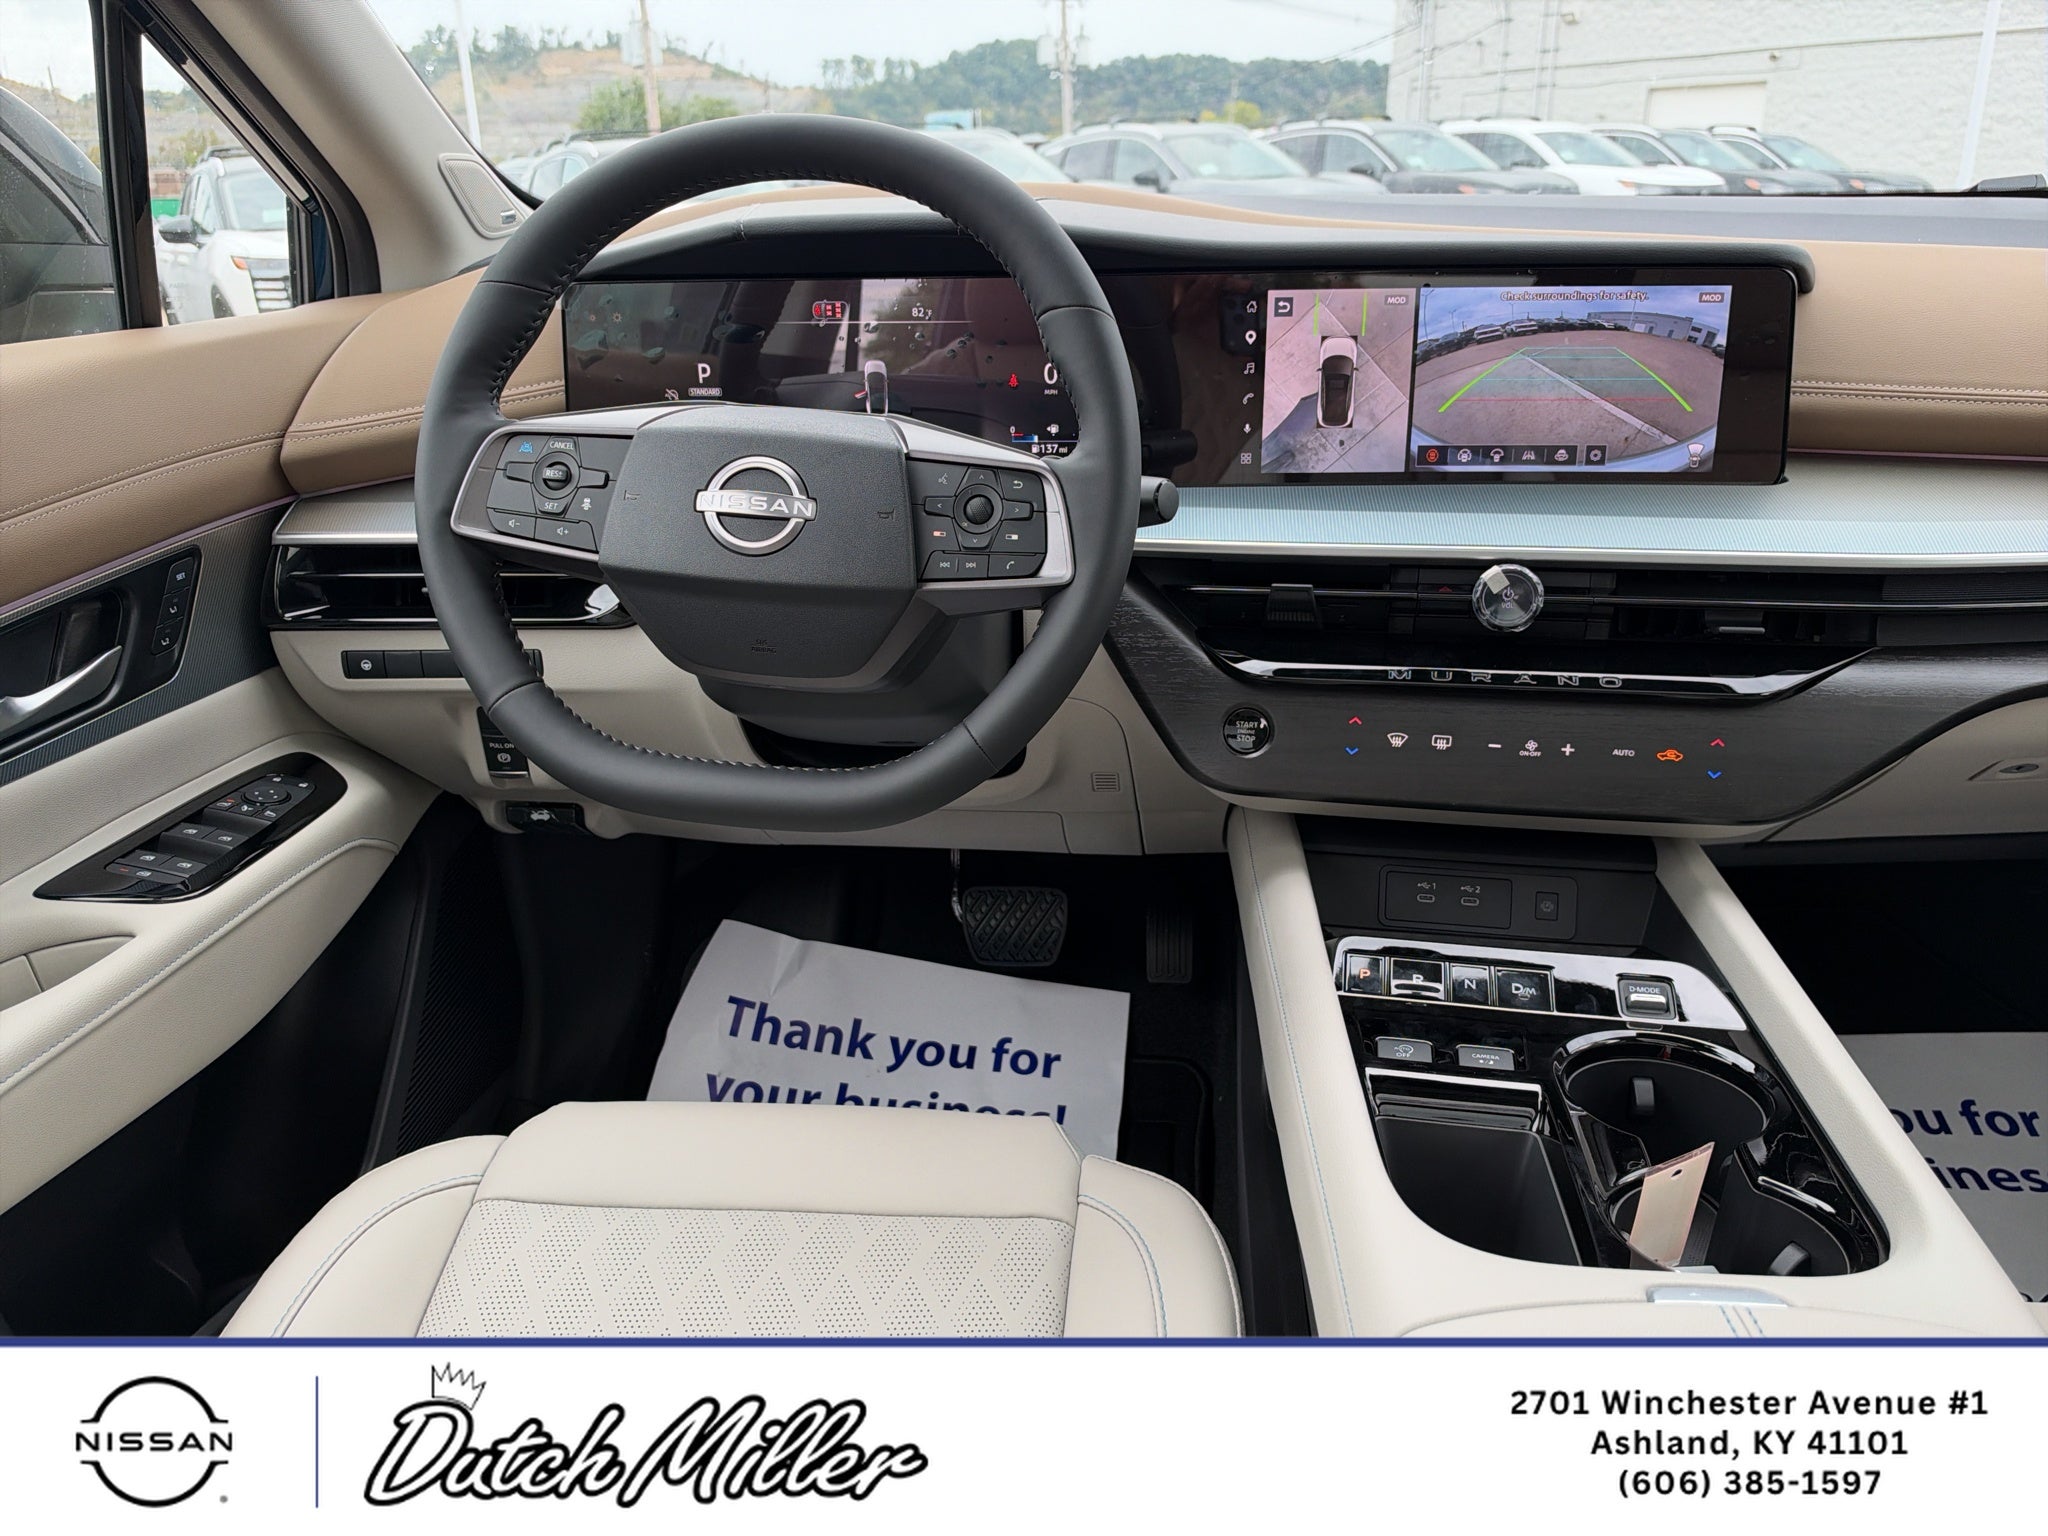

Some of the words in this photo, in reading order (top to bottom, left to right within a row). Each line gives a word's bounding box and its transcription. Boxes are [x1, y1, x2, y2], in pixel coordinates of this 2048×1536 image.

[1387, 296, 1406, 304] MOD
[1501, 291, 1530, 301] Check
[1532, 290, 1597, 304] surroundings
[1599, 290, 1614, 301] for
[1616, 290, 1650, 303] safety.
[1701, 293, 1722, 302] MOD
[912, 307, 924, 317] 82
[697, 362, 711, 384] P
[1043, 362, 1058, 385] 0
[689, 387, 721, 396] STANDARD
[549, 440, 574, 450] CANCEL
[1040, 443, 1058, 454] 137
[700, 494, 813, 517] NISSAN
[175, 572, 186, 581] SET
[1387, 668, 1623, 689] MURANO
[1235, 720, 1259, 729] START
[1236, 734, 1257, 742] STOP
[1612, 748, 1635, 757] AUTO
[1475, 885, 1481, 893] 2
[1359, 968, 1371, 980] P
[1412, 974, 1424, 984] R
[1464, 979, 1477, 990] N
[727, 995, 876, 1060] Thank
[886, 1035, 978, 1074] you
[991, 1036, 1062, 1079] for
[1958, 1099, 2041, 1137] for
